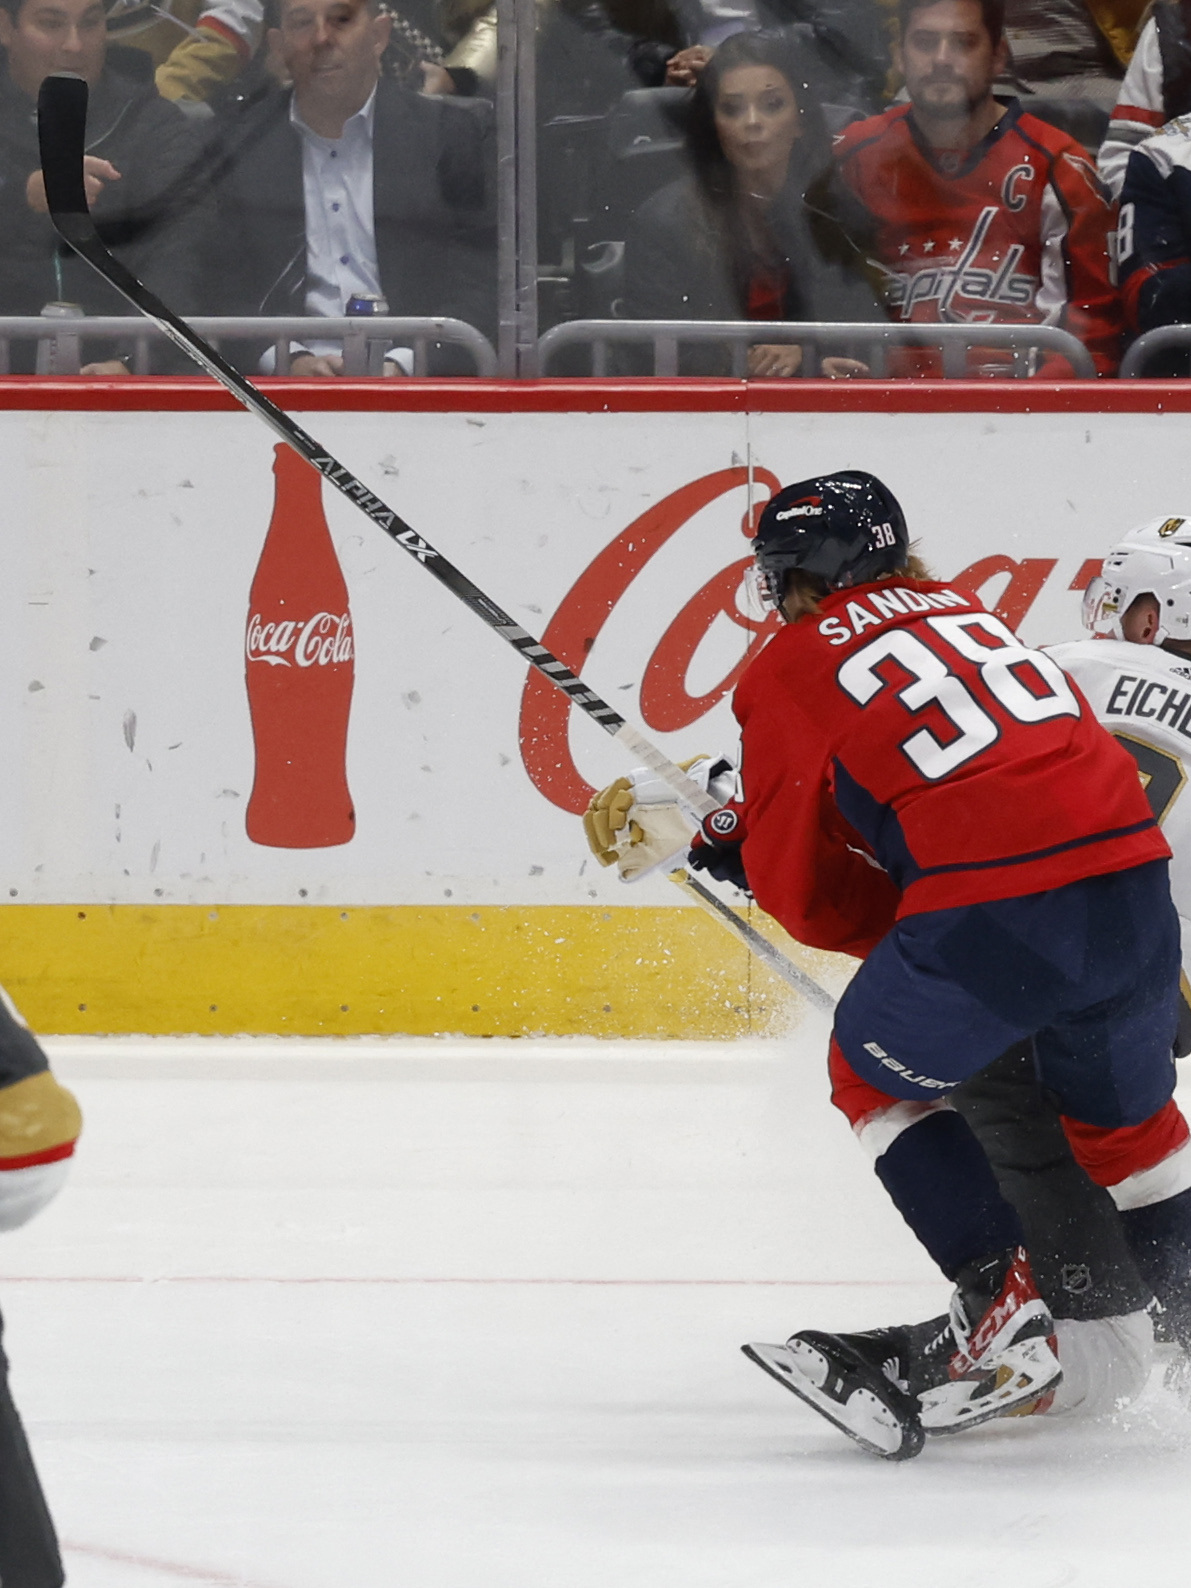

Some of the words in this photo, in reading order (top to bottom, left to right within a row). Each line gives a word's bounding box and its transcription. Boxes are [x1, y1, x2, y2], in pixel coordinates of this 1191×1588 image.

[1002, 164, 1035, 212] C
[884, 206, 1038, 326] apitals
[310, 457, 395, 530] ALPHA
[396, 529, 439, 563] LX
[871, 522, 897, 549] 38
[246, 611, 354, 668] Coca-Cola
[818, 587, 971, 646] SANDIN
[837, 612, 1083, 783] 38
